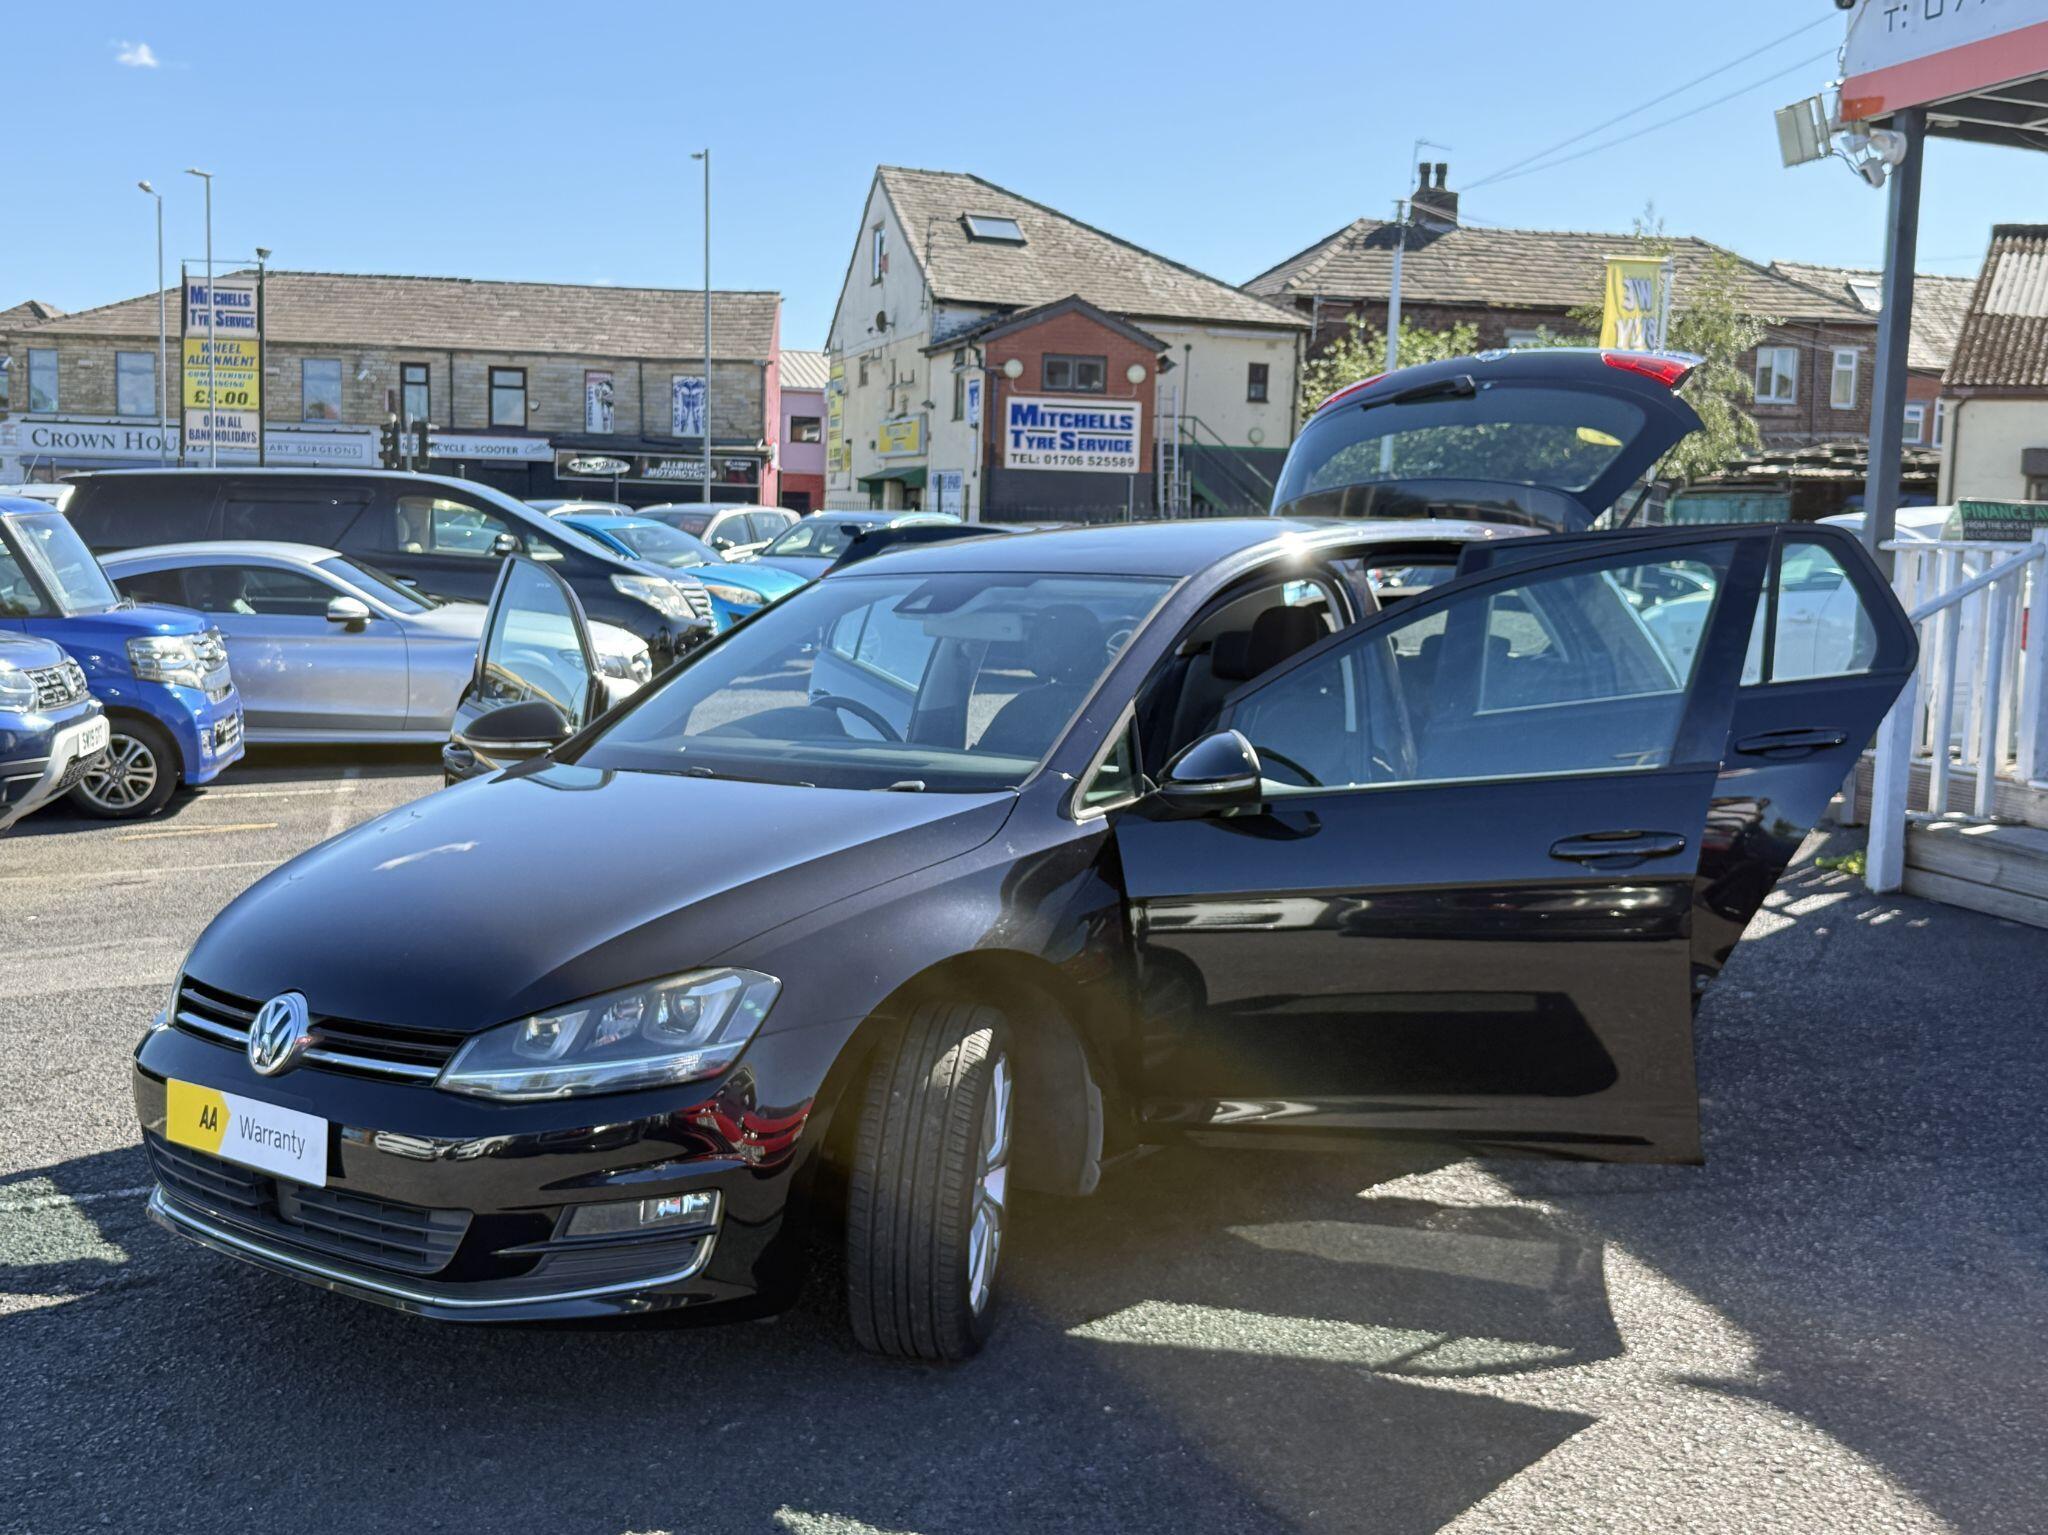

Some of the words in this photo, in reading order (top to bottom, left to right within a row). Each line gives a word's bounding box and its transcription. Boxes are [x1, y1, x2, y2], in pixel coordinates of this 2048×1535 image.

[190, 286, 251, 307] MICHELLS
[190, 309, 213, 327] TYR
[215, 310, 256, 329] SERVICE
[203, 415, 226, 428] OEN
[228, 416, 243, 429] ALL
[1010, 403, 1134, 430] MITCHELLS
[31, 428, 116, 449] CROWN
[215, 429, 257, 443] HOLIDAYS
[1010, 429, 1057, 450] TYRE
[1060, 431, 1133, 453] SERVICE
[1011, 453, 1040, 464] TEL:
[1044, 454, 1084, 465] 01706
[1088, 456, 1135, 467] 525589
[648, 468, 717, 479] MOTORCYCLS
[1962, 502, 2032, 520] FINANCE
[199, 1104, 218, 1133] AA
[239, 1114, 306, 1160] Warranty
